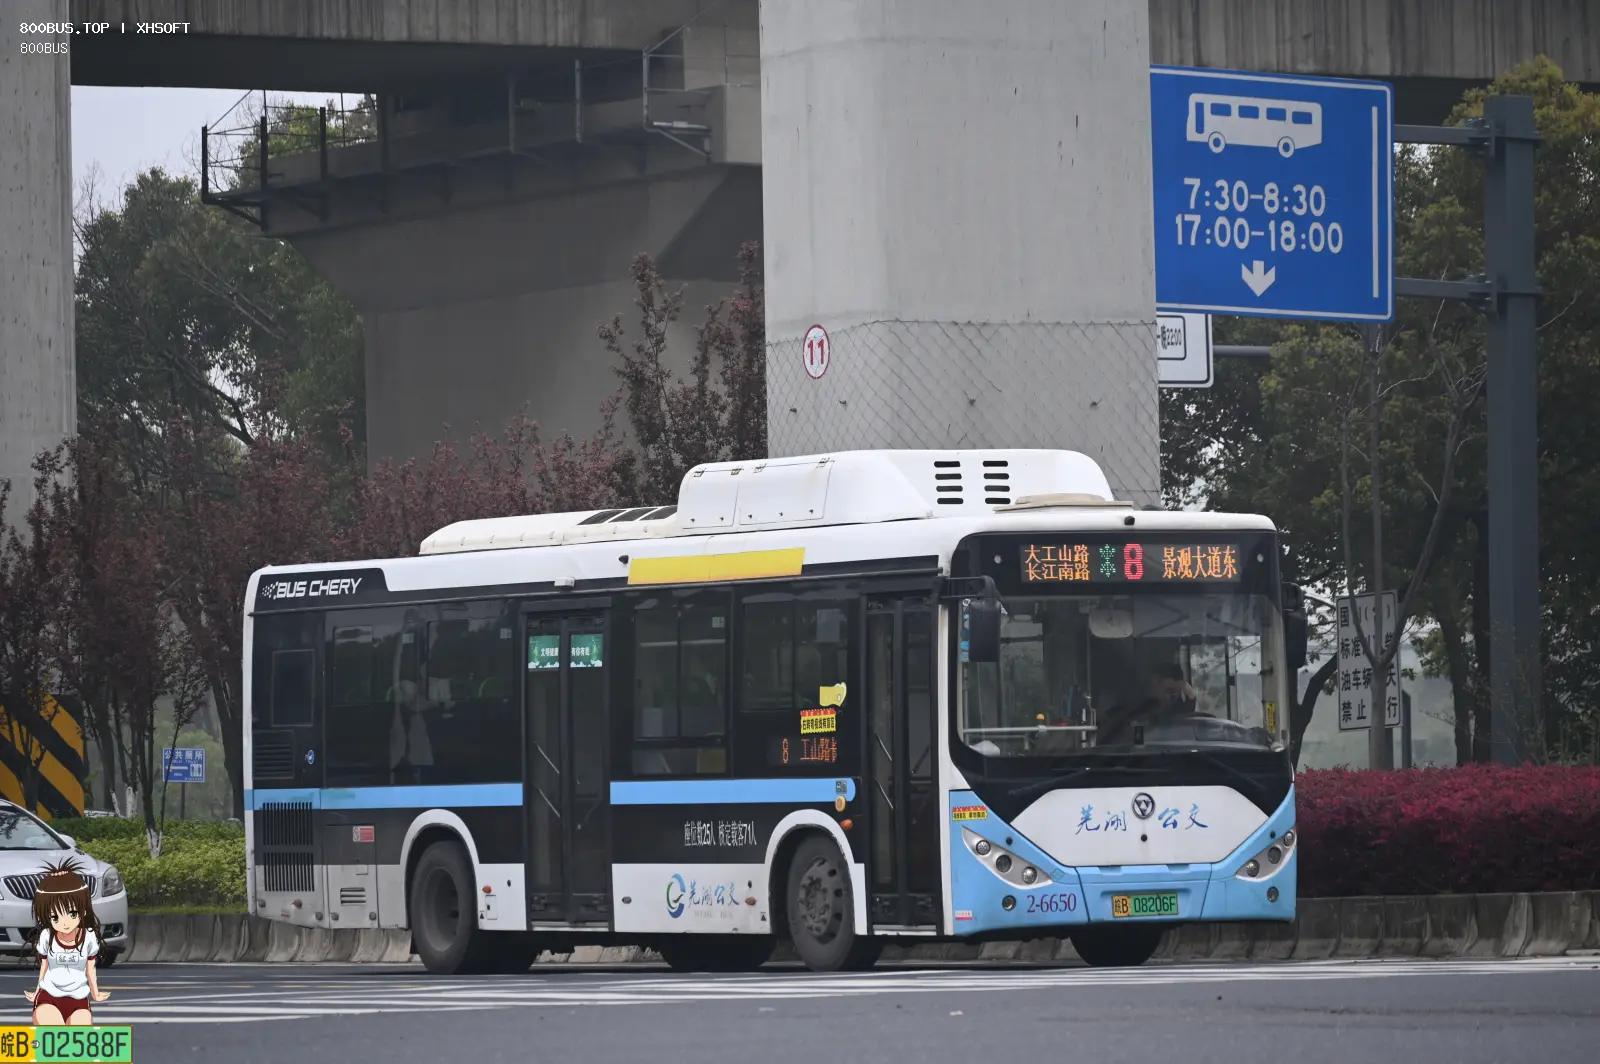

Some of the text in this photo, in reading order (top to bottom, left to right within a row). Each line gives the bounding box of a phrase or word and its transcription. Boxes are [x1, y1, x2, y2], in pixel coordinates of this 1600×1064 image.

[1183, 177, 1326, 217] 7:30-8:30
[1175, 213, 1343, 254] 17:00-18:00
[807, 338, 825, 366] 11
[1024, 544, 1090, 564] 大工山路
[1123, 543, 1144, 580] 8
[1162, 545, 1238, 579] 景观大道东
[1025, 562, 1091, 581] 长江南路
[275, 577, 362, 600] BUS CHERY
[1342, 696, 1398, 723] 禁止行
[1026, 893, 1077, 913] 2-6650
